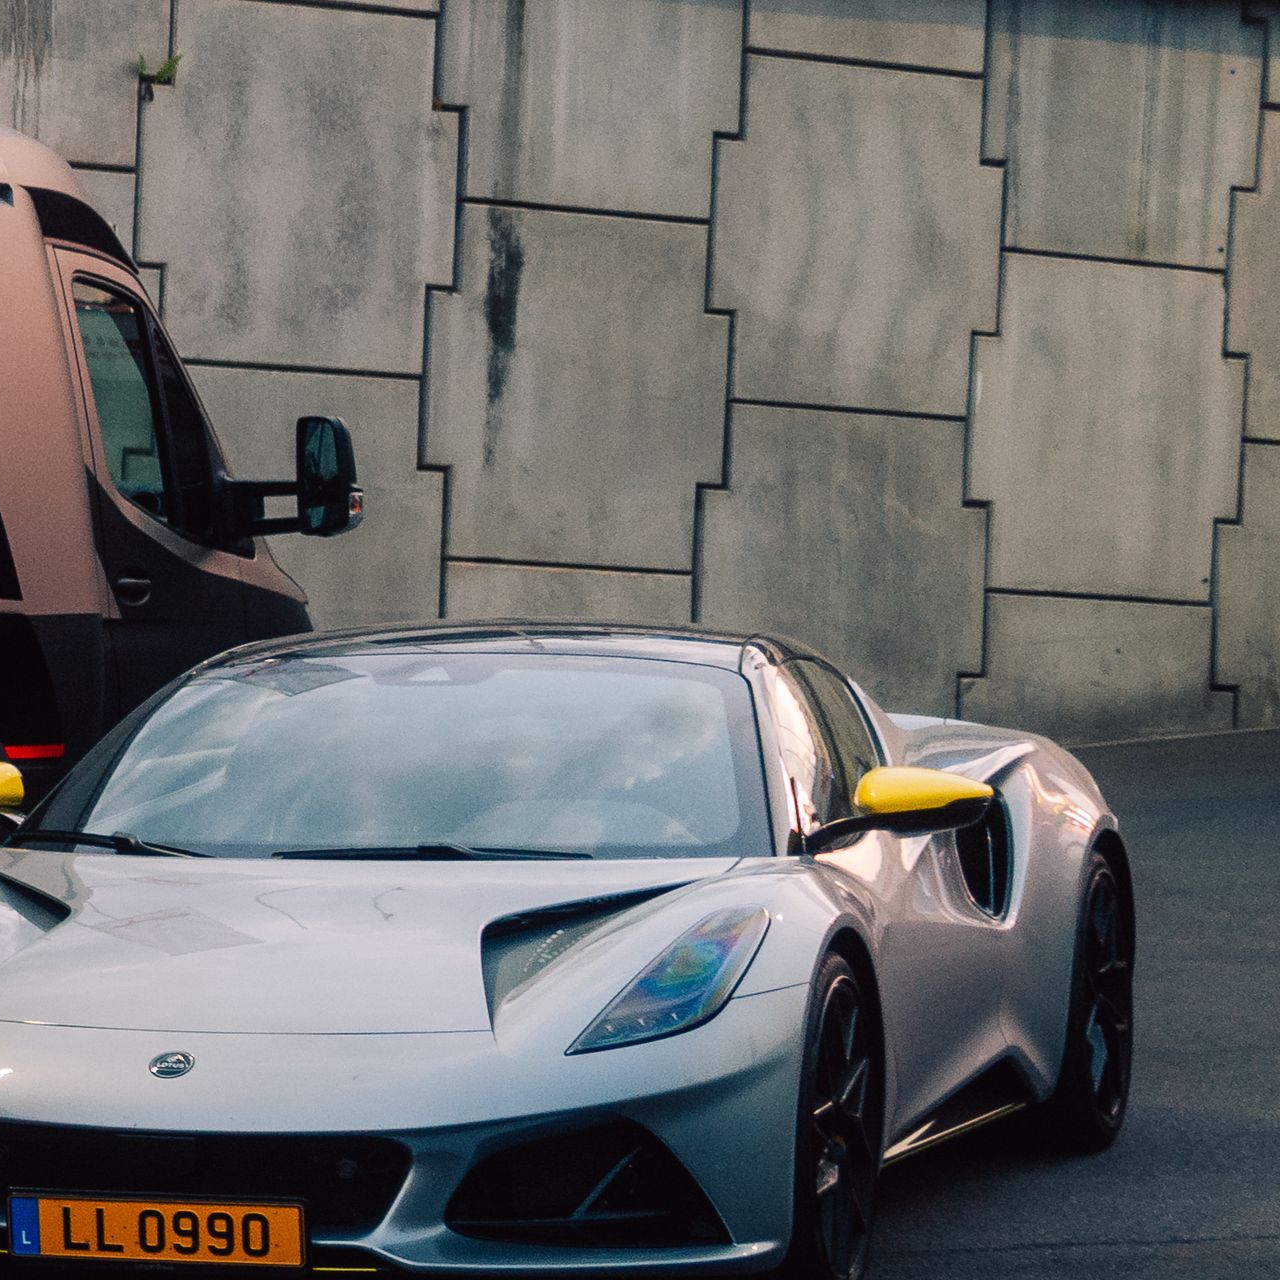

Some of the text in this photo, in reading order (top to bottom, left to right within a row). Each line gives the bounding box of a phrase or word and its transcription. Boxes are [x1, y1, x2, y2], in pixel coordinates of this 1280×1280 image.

[21, 1206, 270, 1257] L LL 0990
